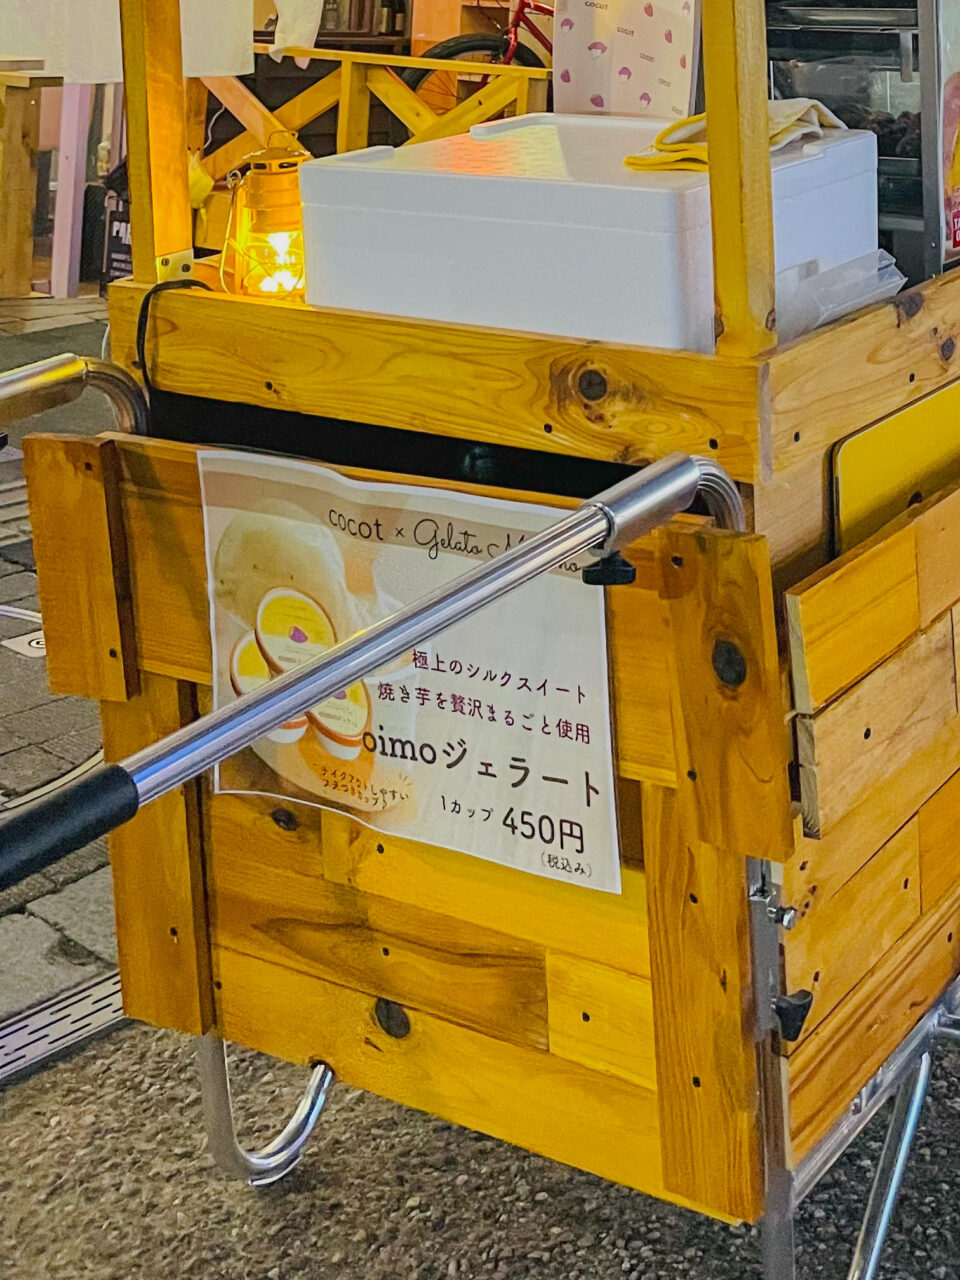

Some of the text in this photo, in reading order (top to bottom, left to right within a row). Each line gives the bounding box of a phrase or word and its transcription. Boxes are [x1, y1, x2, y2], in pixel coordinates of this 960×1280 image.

[585, 0, 608, 10] cocot
[328, 508, 384, 541] cocot
[413, 517, 483, 560] Gelato
[412, 649, 586, 705] 極上のシルクスイート
[377, 682, 591, 745] 焼き芋を贅沢まるごと使用
[362, 724, 600, 808] oimoジェラート
[503, 806, 585, 854] 450円
[541, 852, 593, 878] (税込み)
